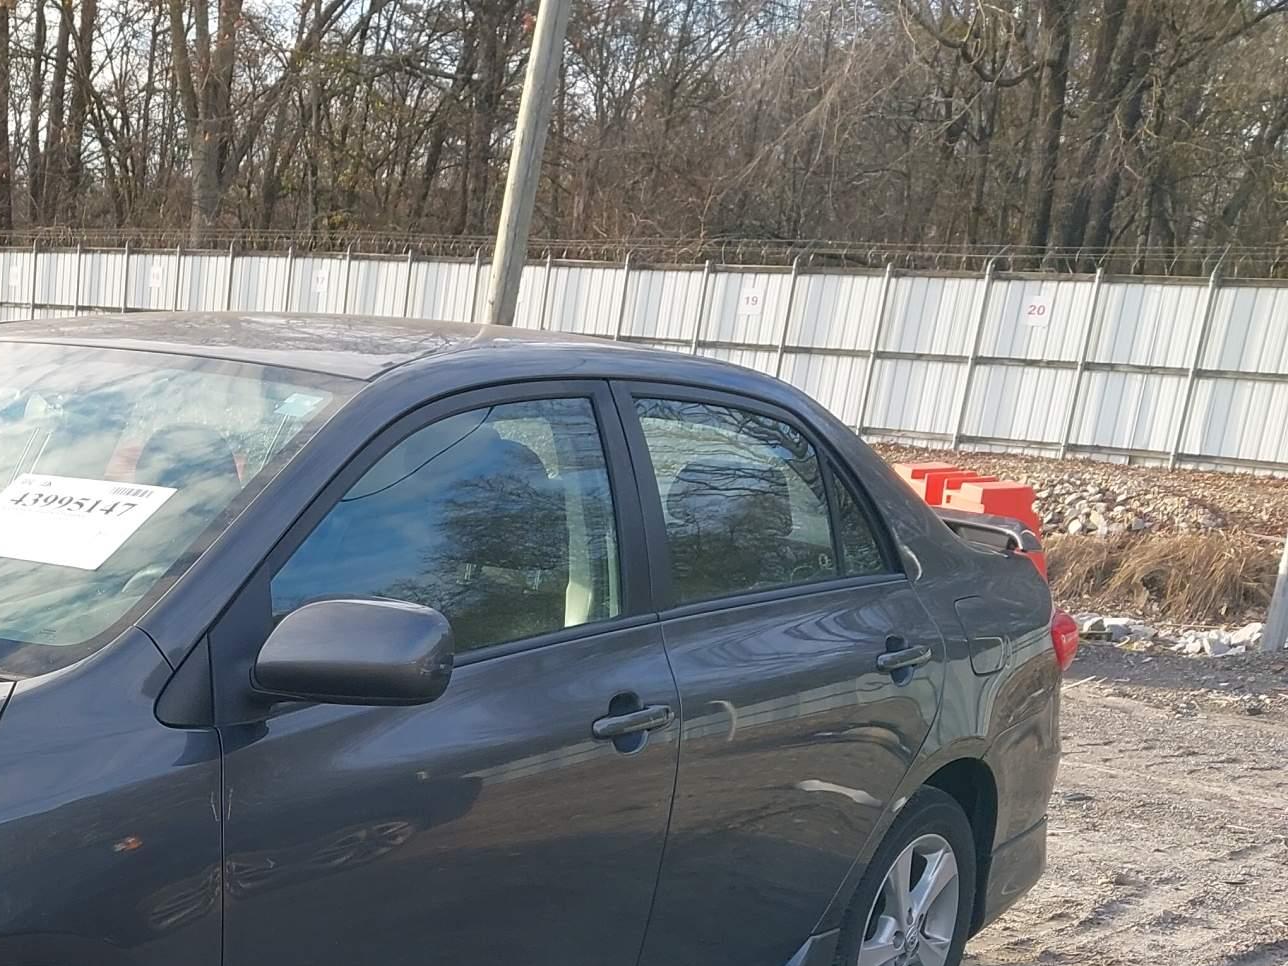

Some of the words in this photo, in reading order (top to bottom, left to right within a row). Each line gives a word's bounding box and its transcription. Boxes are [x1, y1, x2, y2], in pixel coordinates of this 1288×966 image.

[744, 295, 759, 306] 19
[1027, 303, 1047, 317] 20
[10, 492, 138, 517] 43995147
